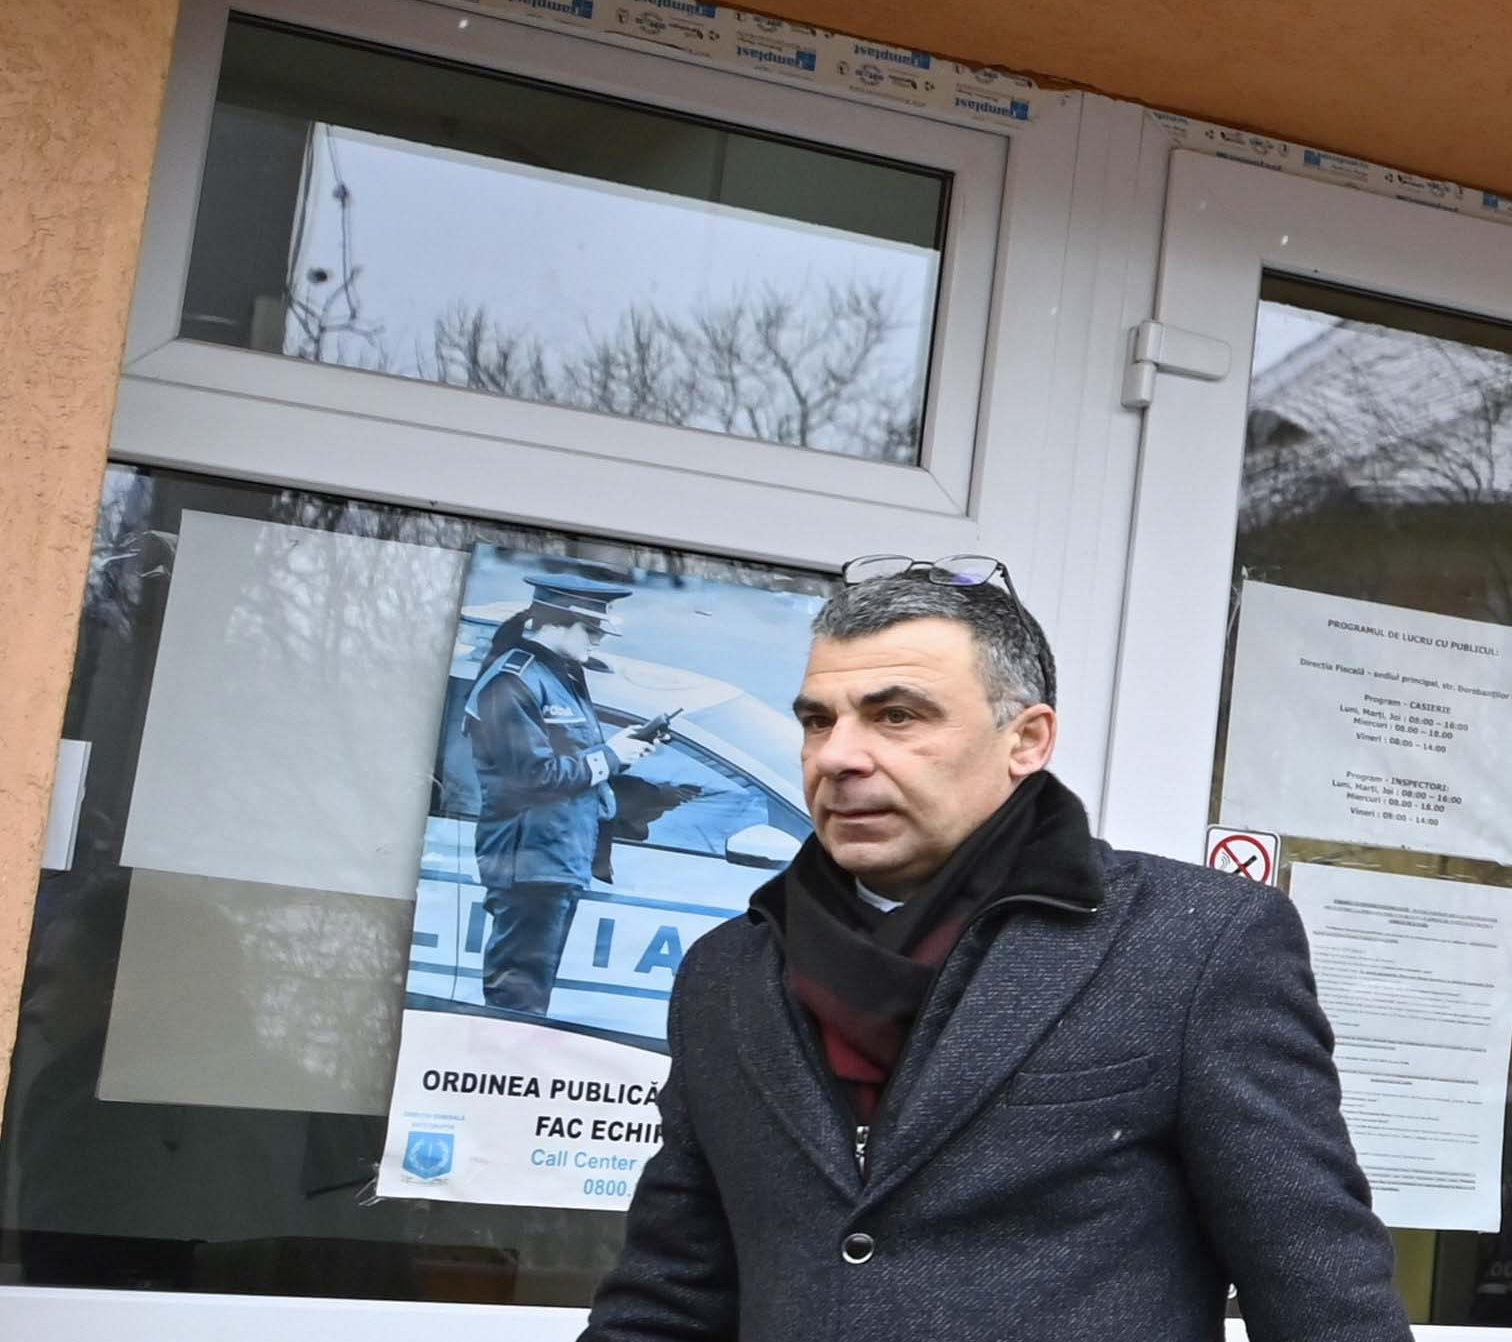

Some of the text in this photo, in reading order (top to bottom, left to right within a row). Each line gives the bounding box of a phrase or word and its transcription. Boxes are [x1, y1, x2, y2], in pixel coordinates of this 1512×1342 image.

[1328, 619, 1385, 637] PROGRAMUL
[1388, 630, 1400, 639] DE
[1402, 633, 1433, 646] LUCRU
[1435, 639, 1449, 648] CU
[1364, 694, 1401, 706] Program
[1409, 701, 1451, 714] CASIERIE
[1346, 771, 1383, 782] Program
[422, 1070, 659, 1106] ORDINEA PUBLICĂ
[535, 1116, 583, 1139] FAC
[530, 1149, 637, 1172] Call Center
